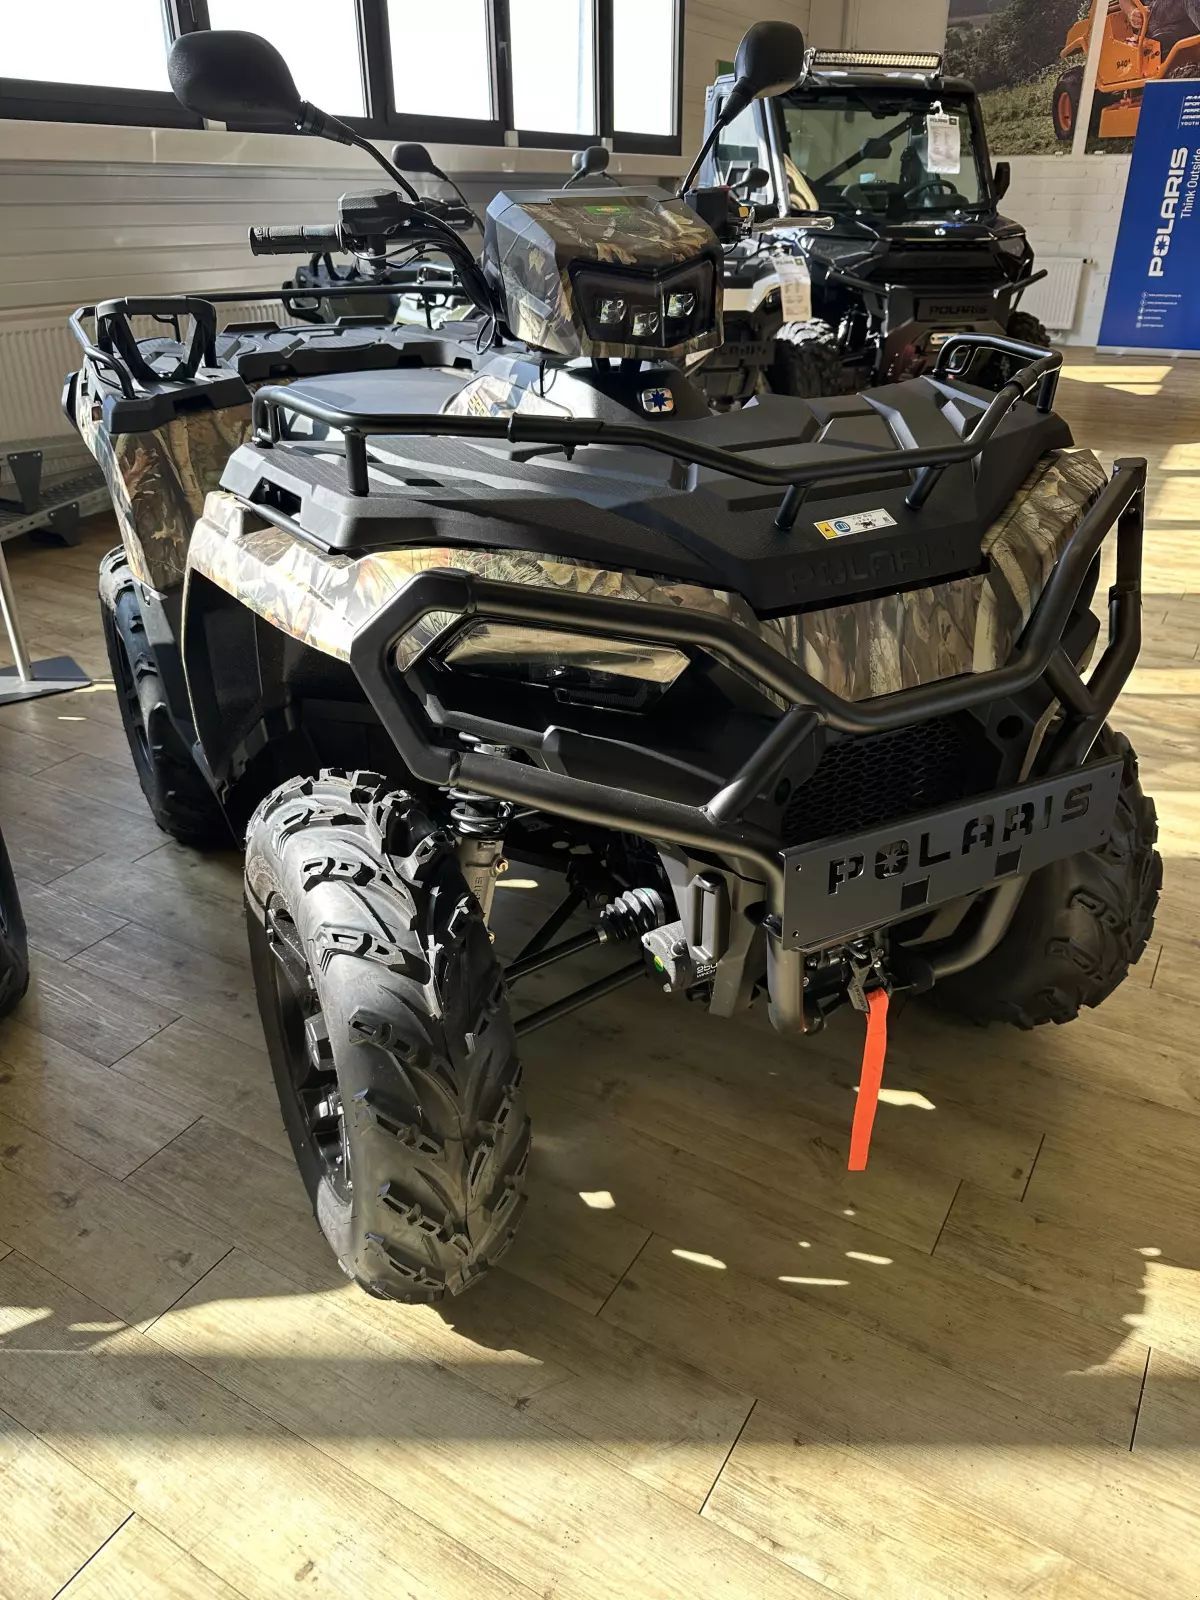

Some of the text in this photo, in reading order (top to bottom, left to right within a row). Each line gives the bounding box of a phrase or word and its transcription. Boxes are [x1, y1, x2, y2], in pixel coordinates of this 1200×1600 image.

[1147, 146, 1189, 278] POLARIS
[1179, 189, 1197, 219] Think
[828, 783, 1093, 896] POLARIS
